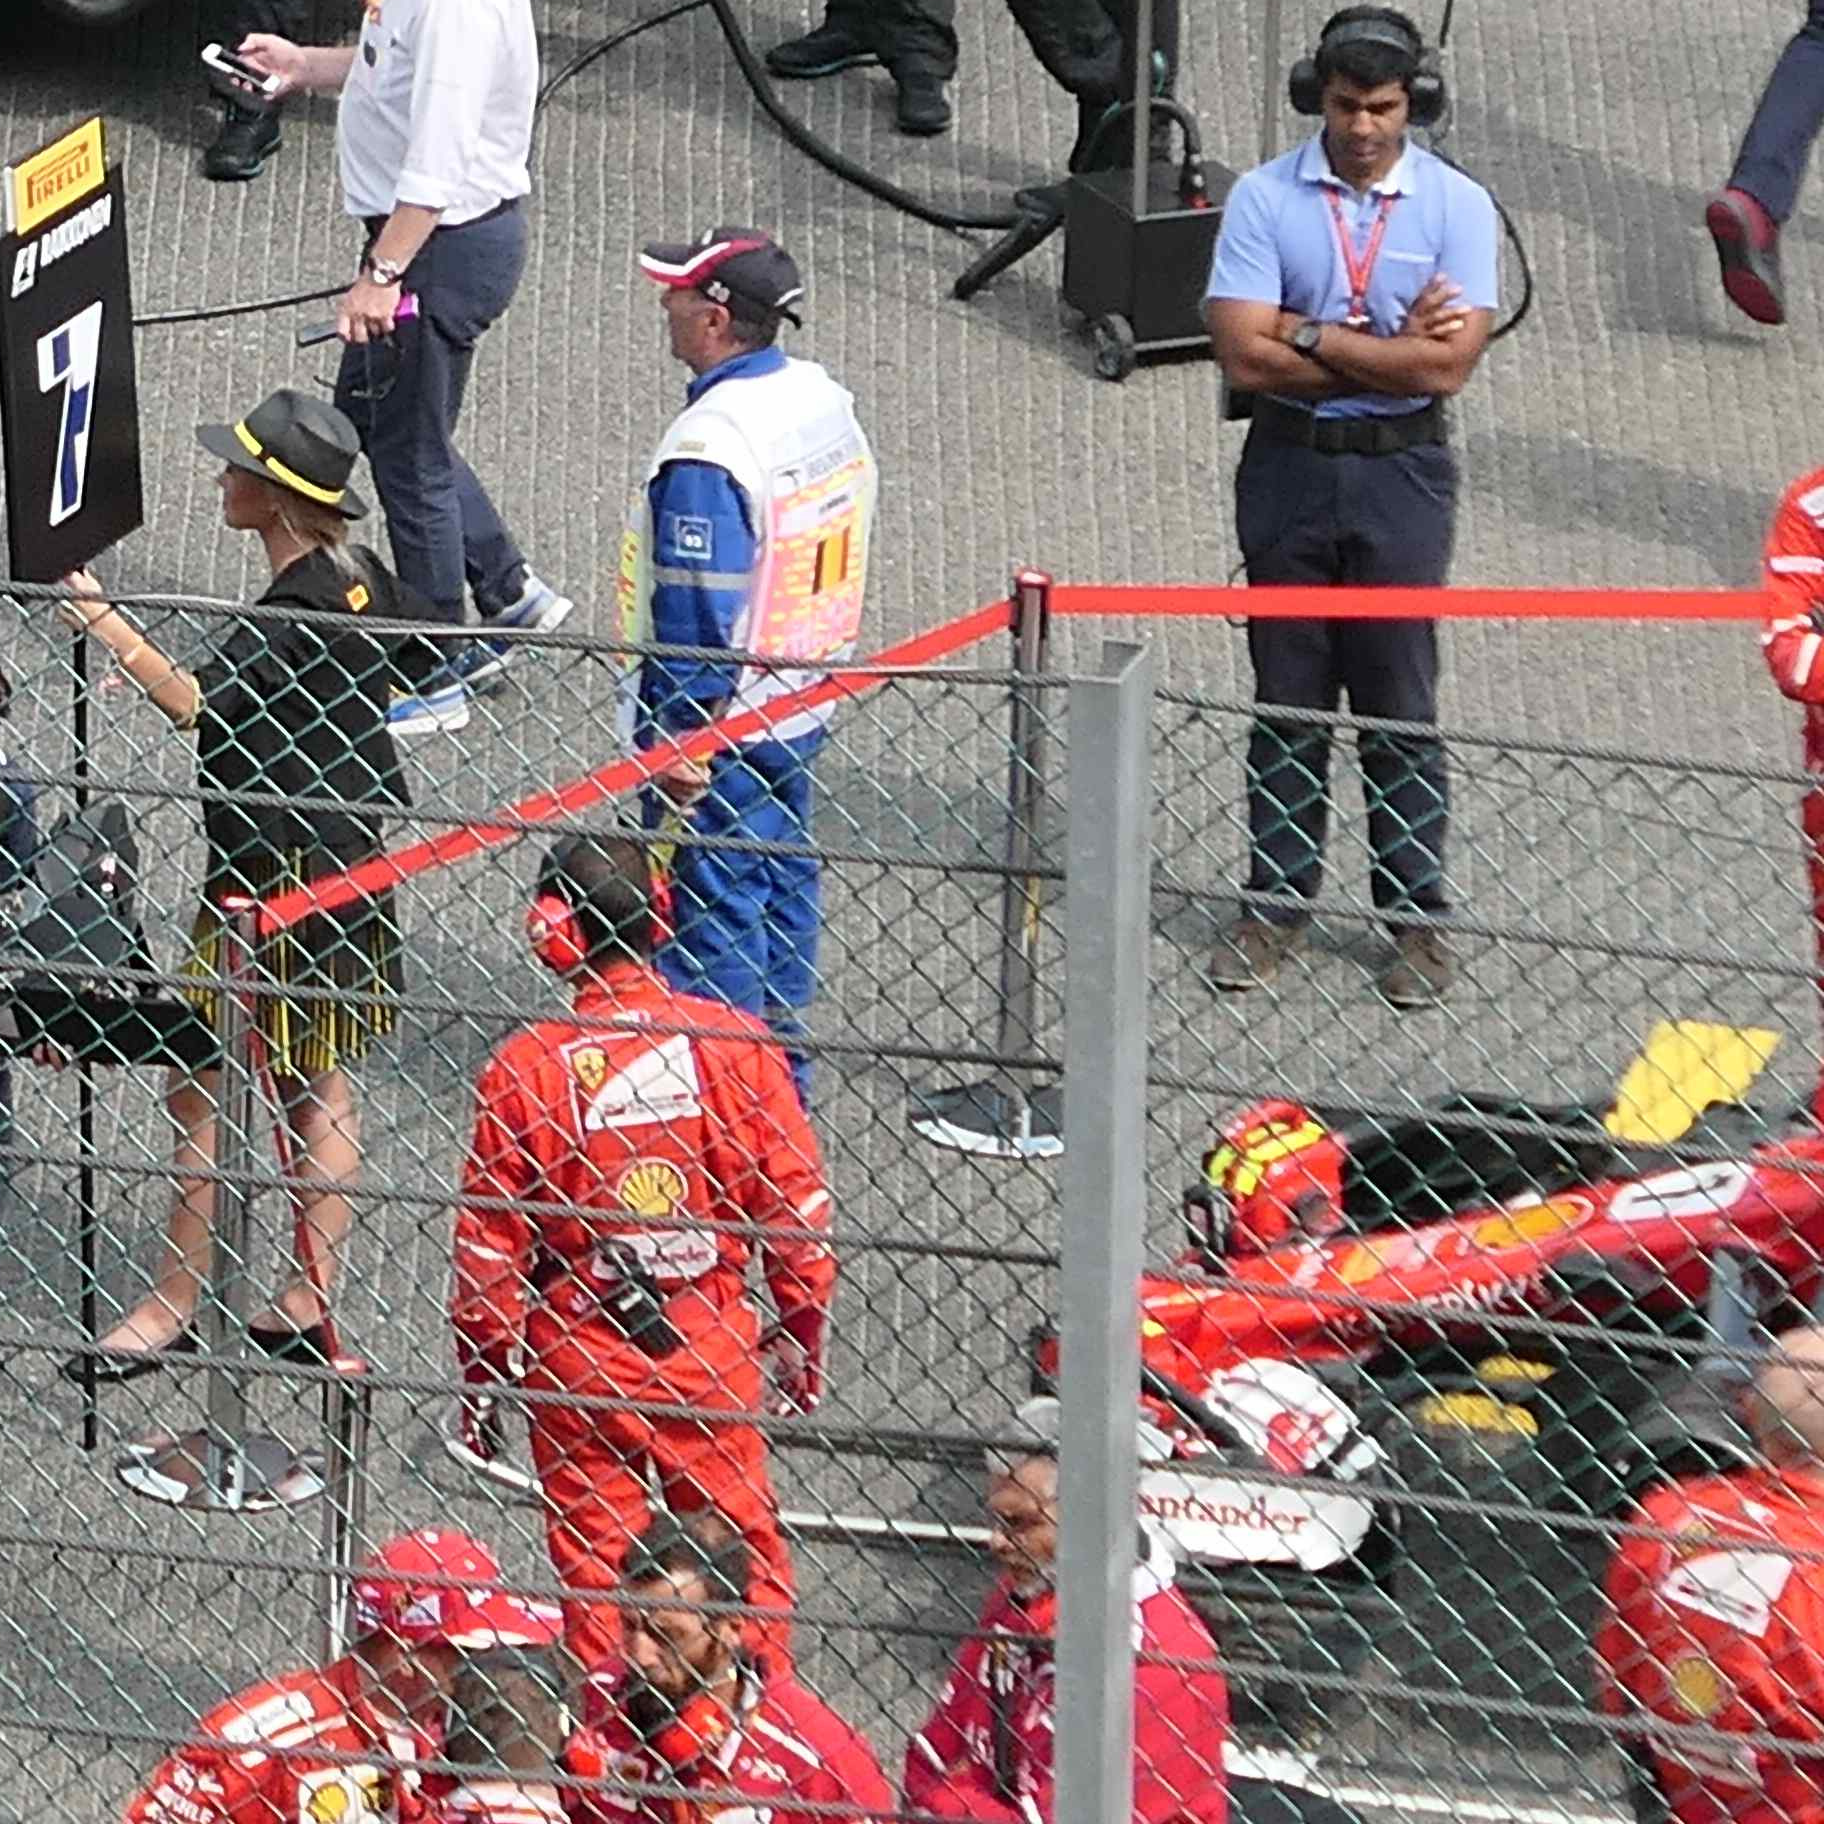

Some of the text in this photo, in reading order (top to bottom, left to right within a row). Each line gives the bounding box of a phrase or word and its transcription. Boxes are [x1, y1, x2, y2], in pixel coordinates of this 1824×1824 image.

[25, 141, 90, 209] PIRELLI
[36, 301, 103, 527] 7
[1140, 1493, 1309, 1537] antander
